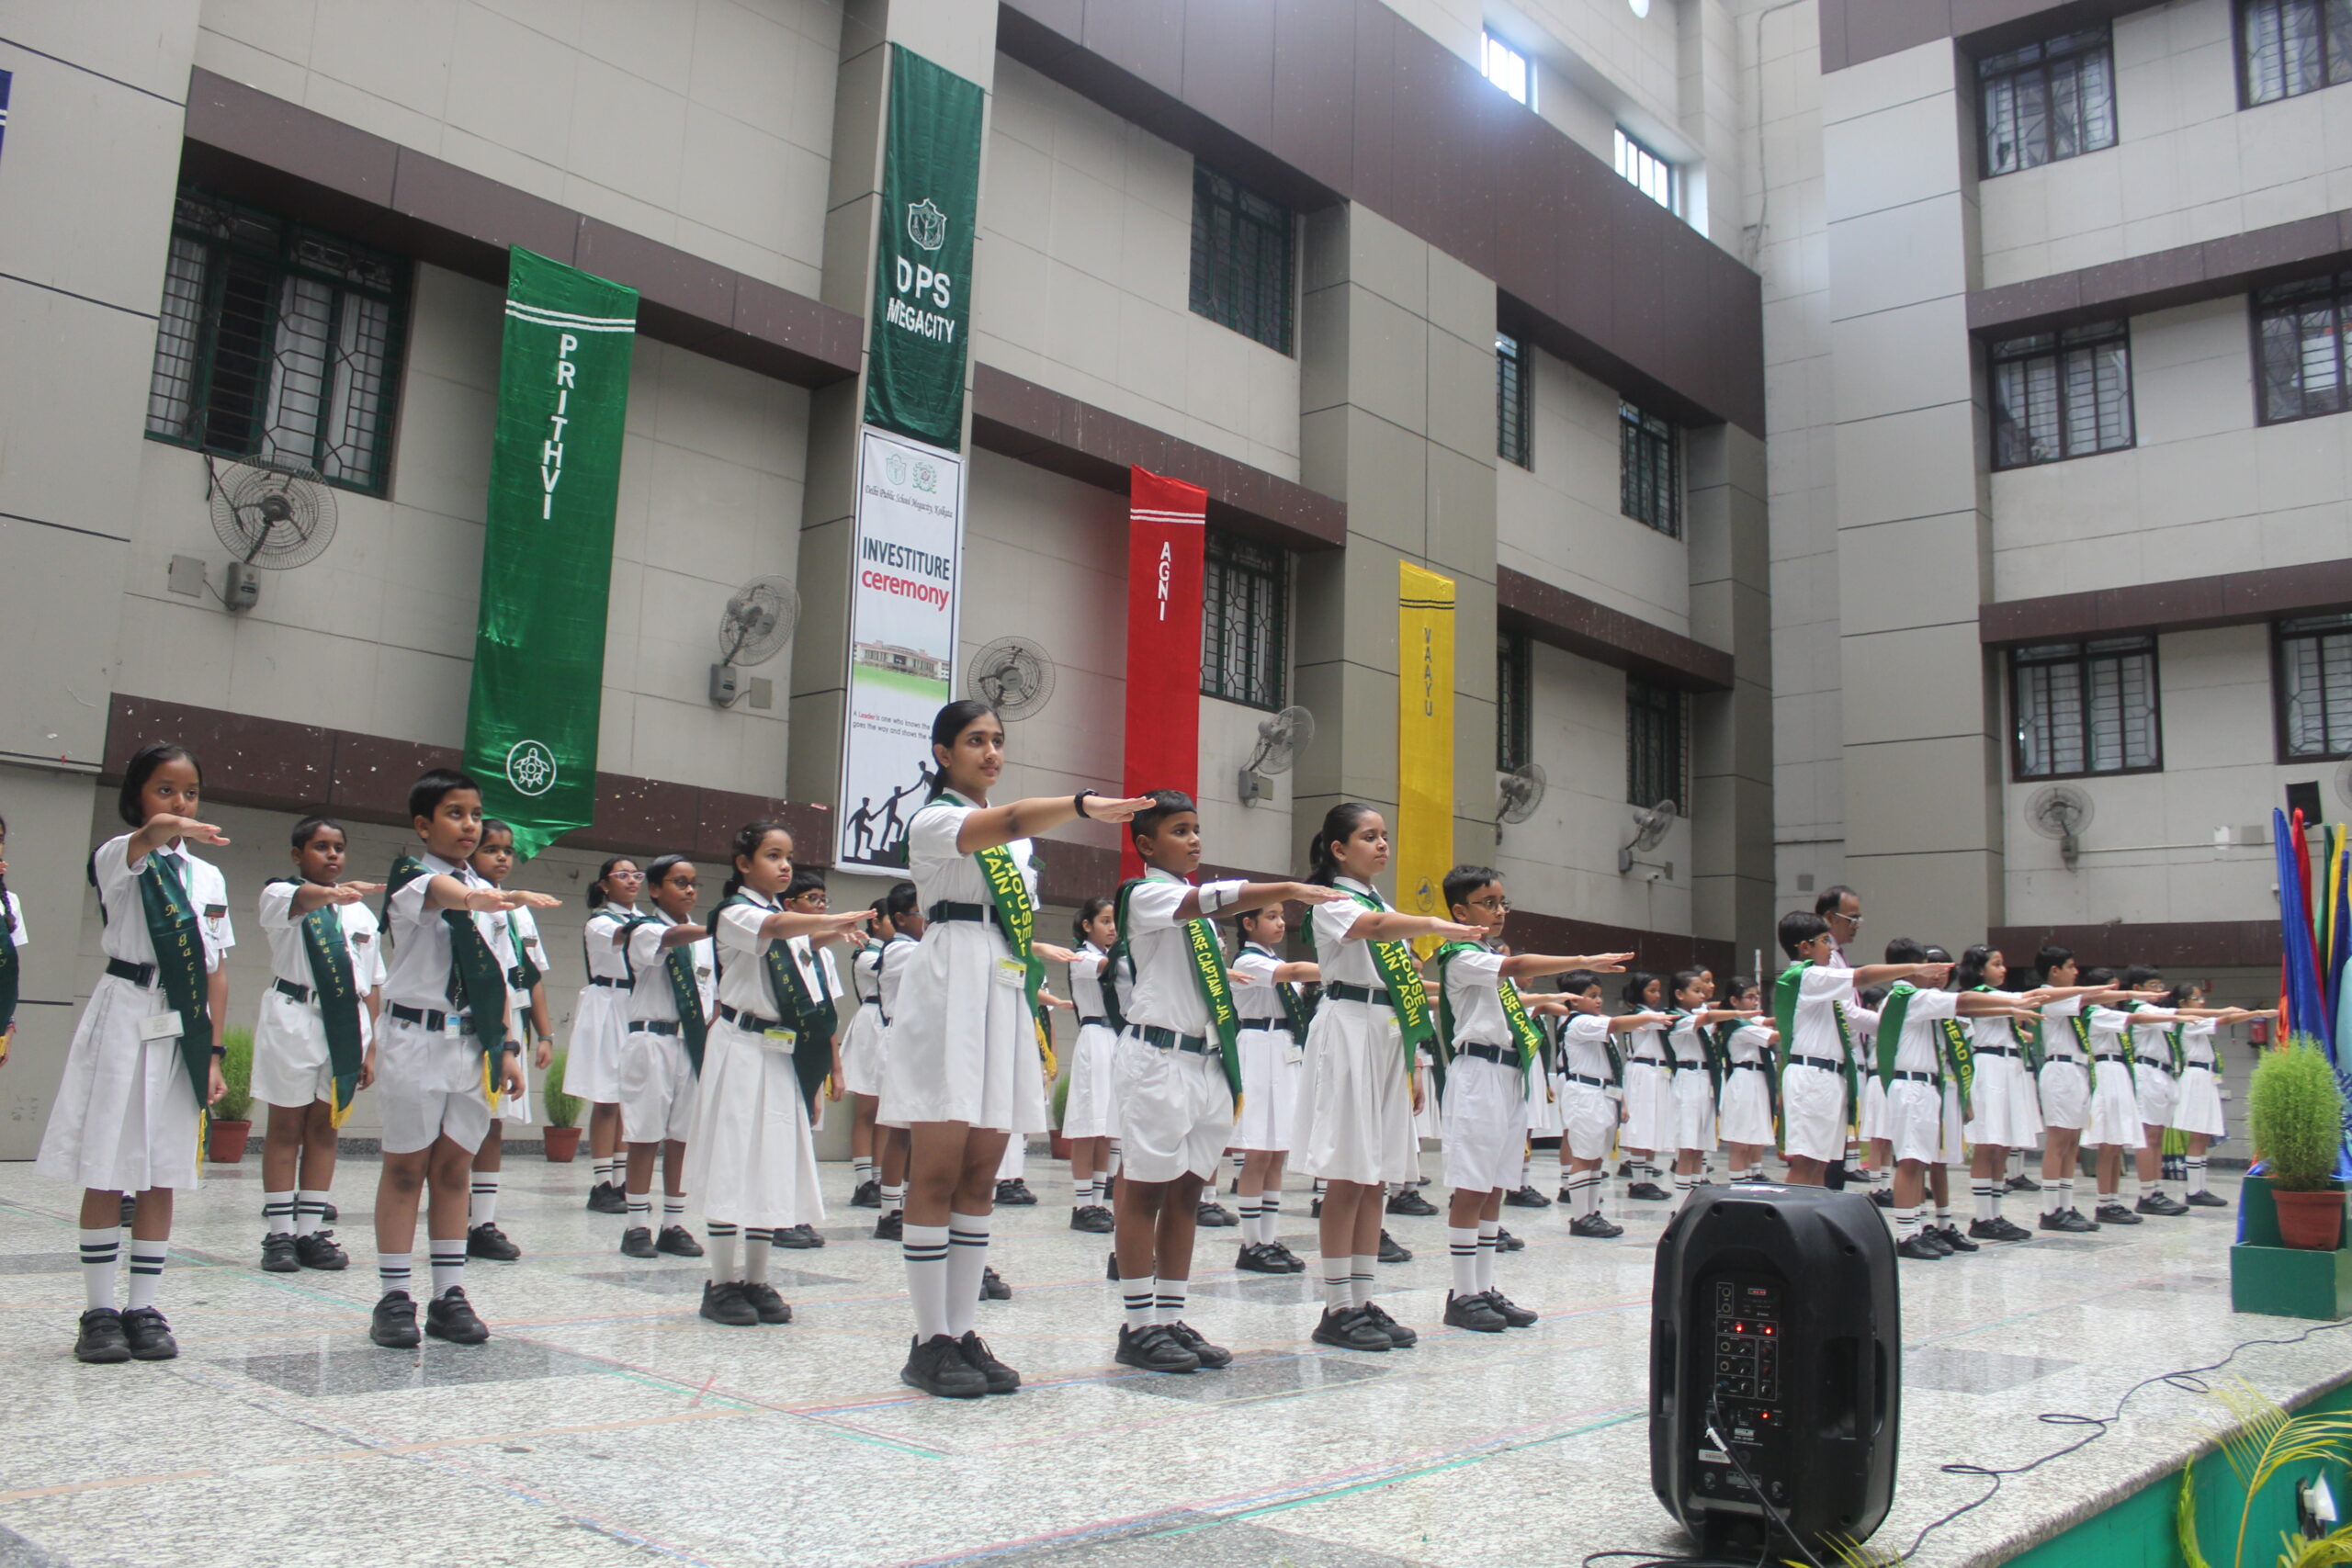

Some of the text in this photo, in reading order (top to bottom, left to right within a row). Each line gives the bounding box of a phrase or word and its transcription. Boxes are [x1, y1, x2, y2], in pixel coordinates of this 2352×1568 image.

[897, 255, 951, 309] DPS
[887, 298, 956, 344] MEGACITY
[540, 333, 578, 520] PRITHVI
[863, 536, 950, 581] INVESTITURE
[1158, 541, 1171, 621] AGNI
[862, 570, 949, 612] ceremony
[1423, 627, 1433, 716] VAAYU
[1004, 862, 1033, 942] HOUSE
[1197, 952, 1224, 998] CAPTAIN
[1395, 946, 1426, 1008] HOUSE
[1396, 985, 1420, 1027] AGNI
[1943, 1020, 1969, 1061] HEAD
